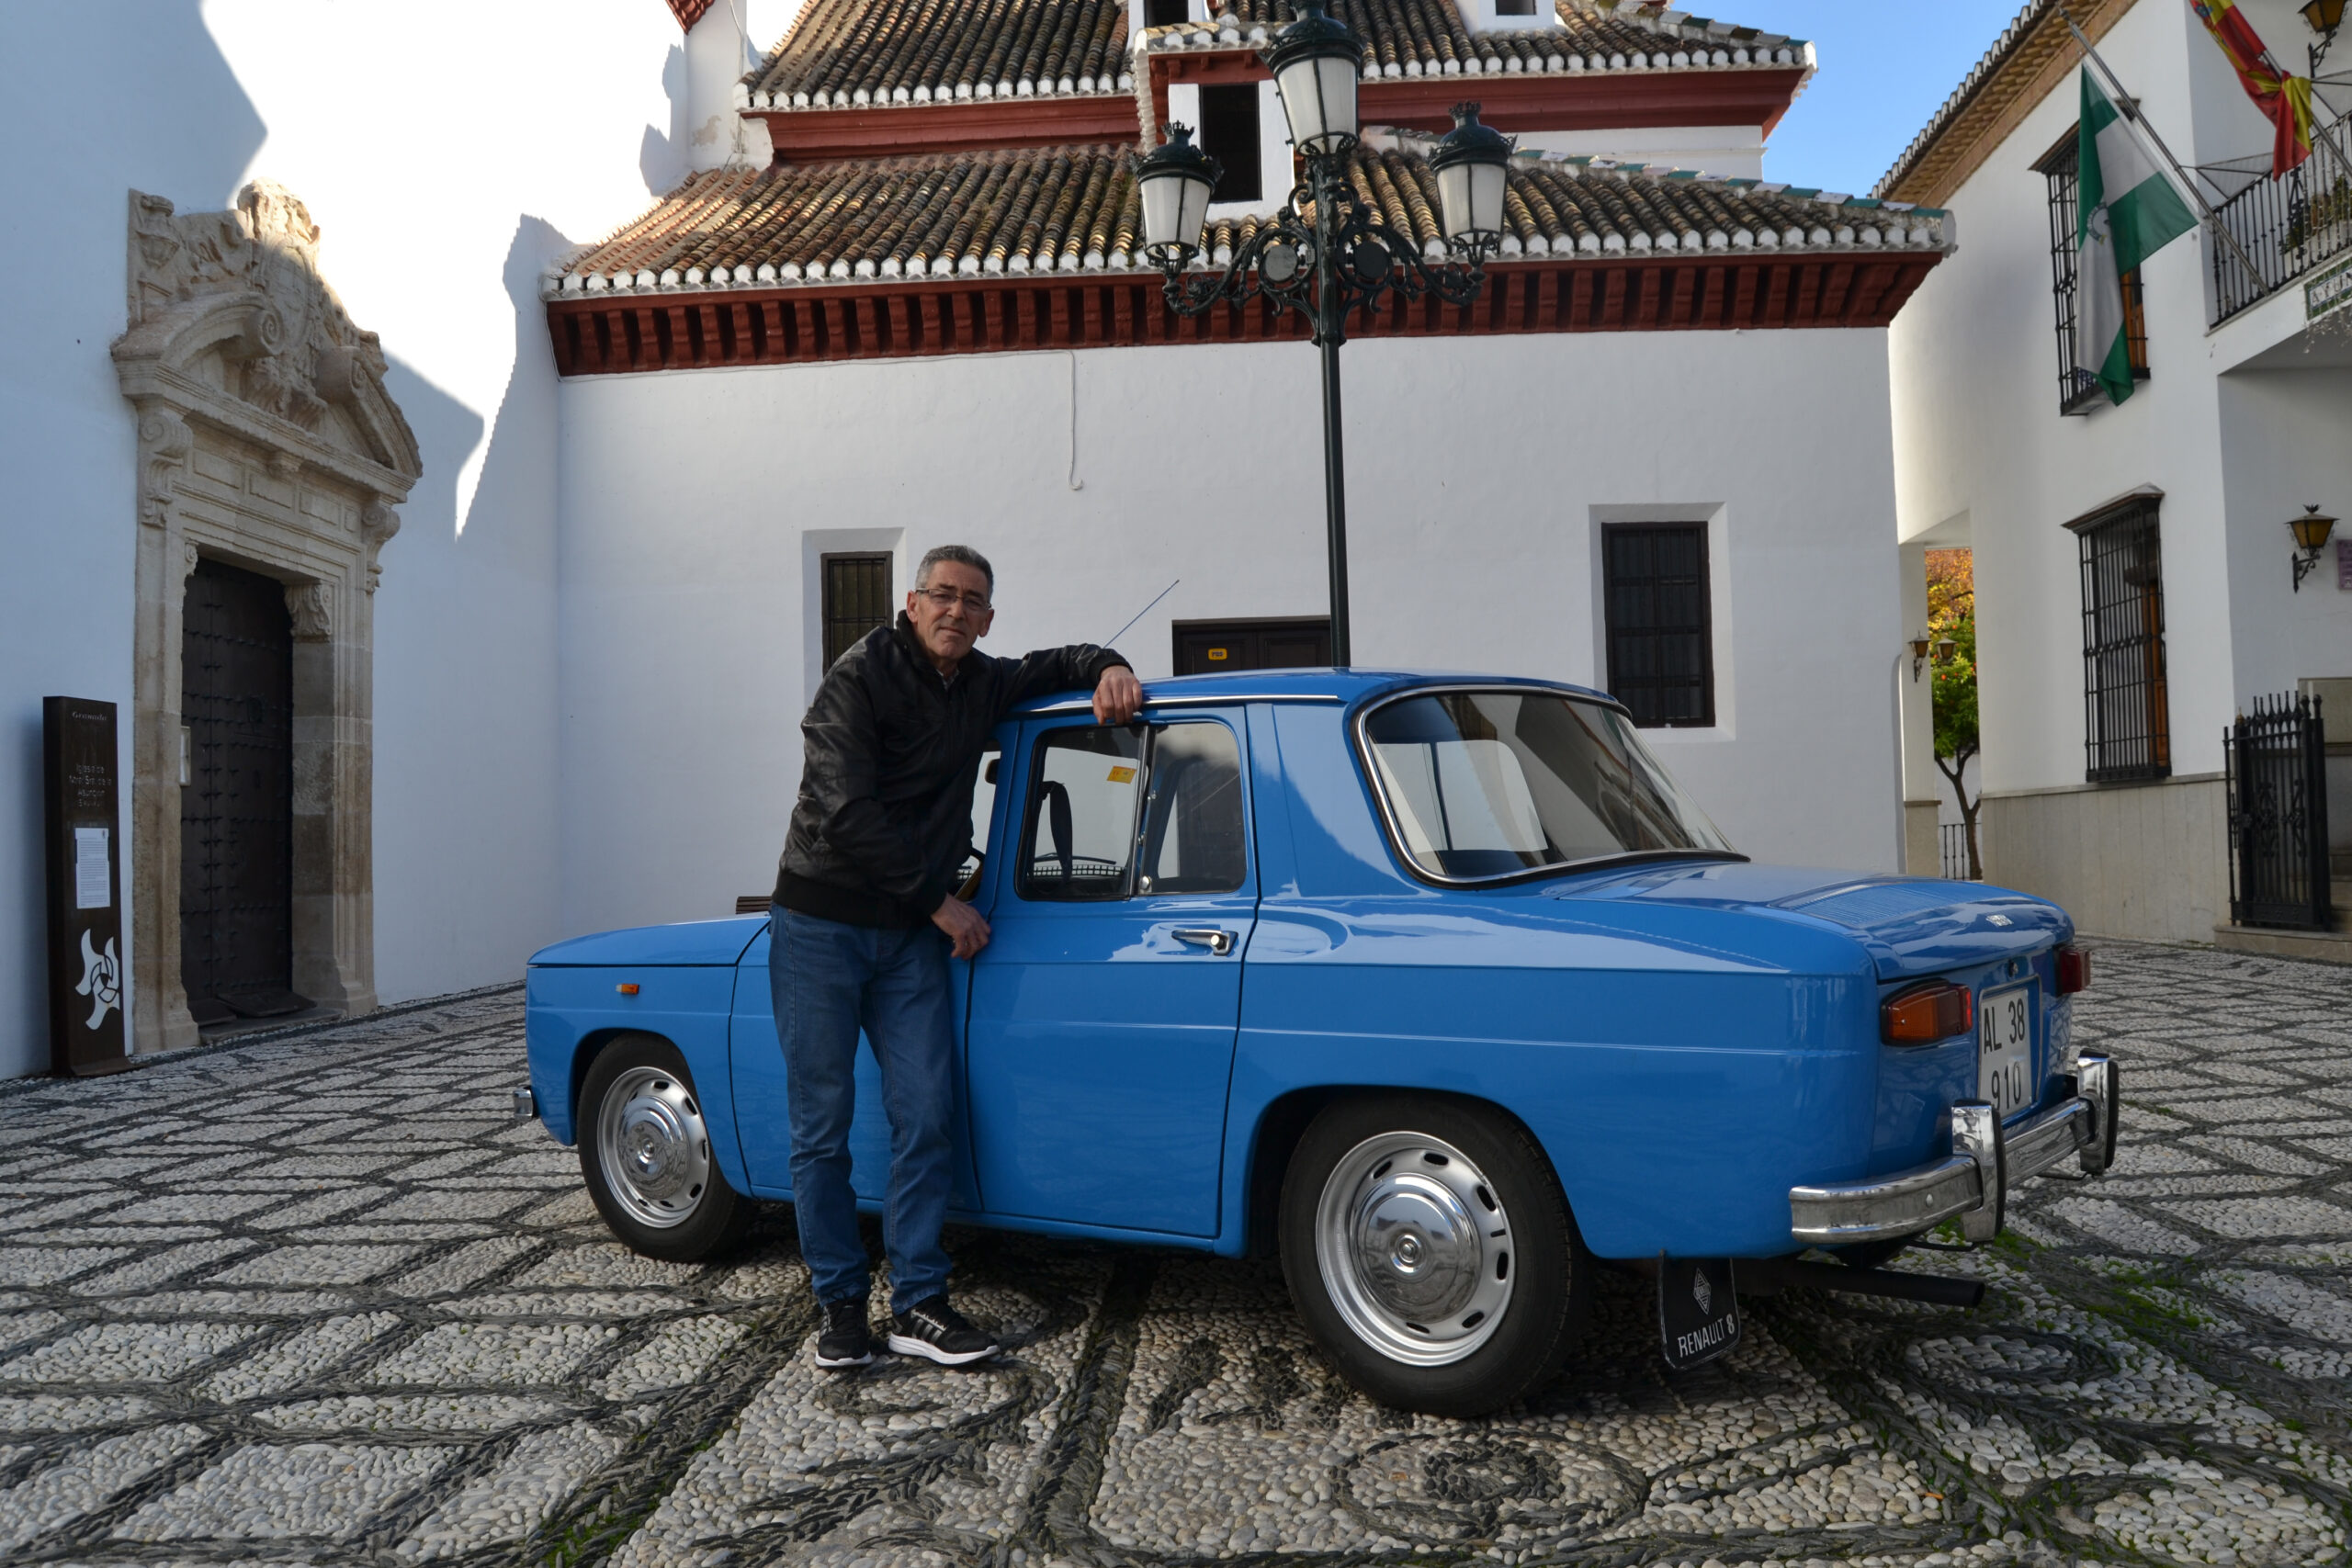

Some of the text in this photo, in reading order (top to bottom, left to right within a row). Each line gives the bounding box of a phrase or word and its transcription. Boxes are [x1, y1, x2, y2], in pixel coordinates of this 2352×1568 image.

[1984, 998, 2025, 1054] AL 38
[1991, 1061, 2021, 1111] 910
[1678, 1314, 1736, 1358] RENAULT 8
